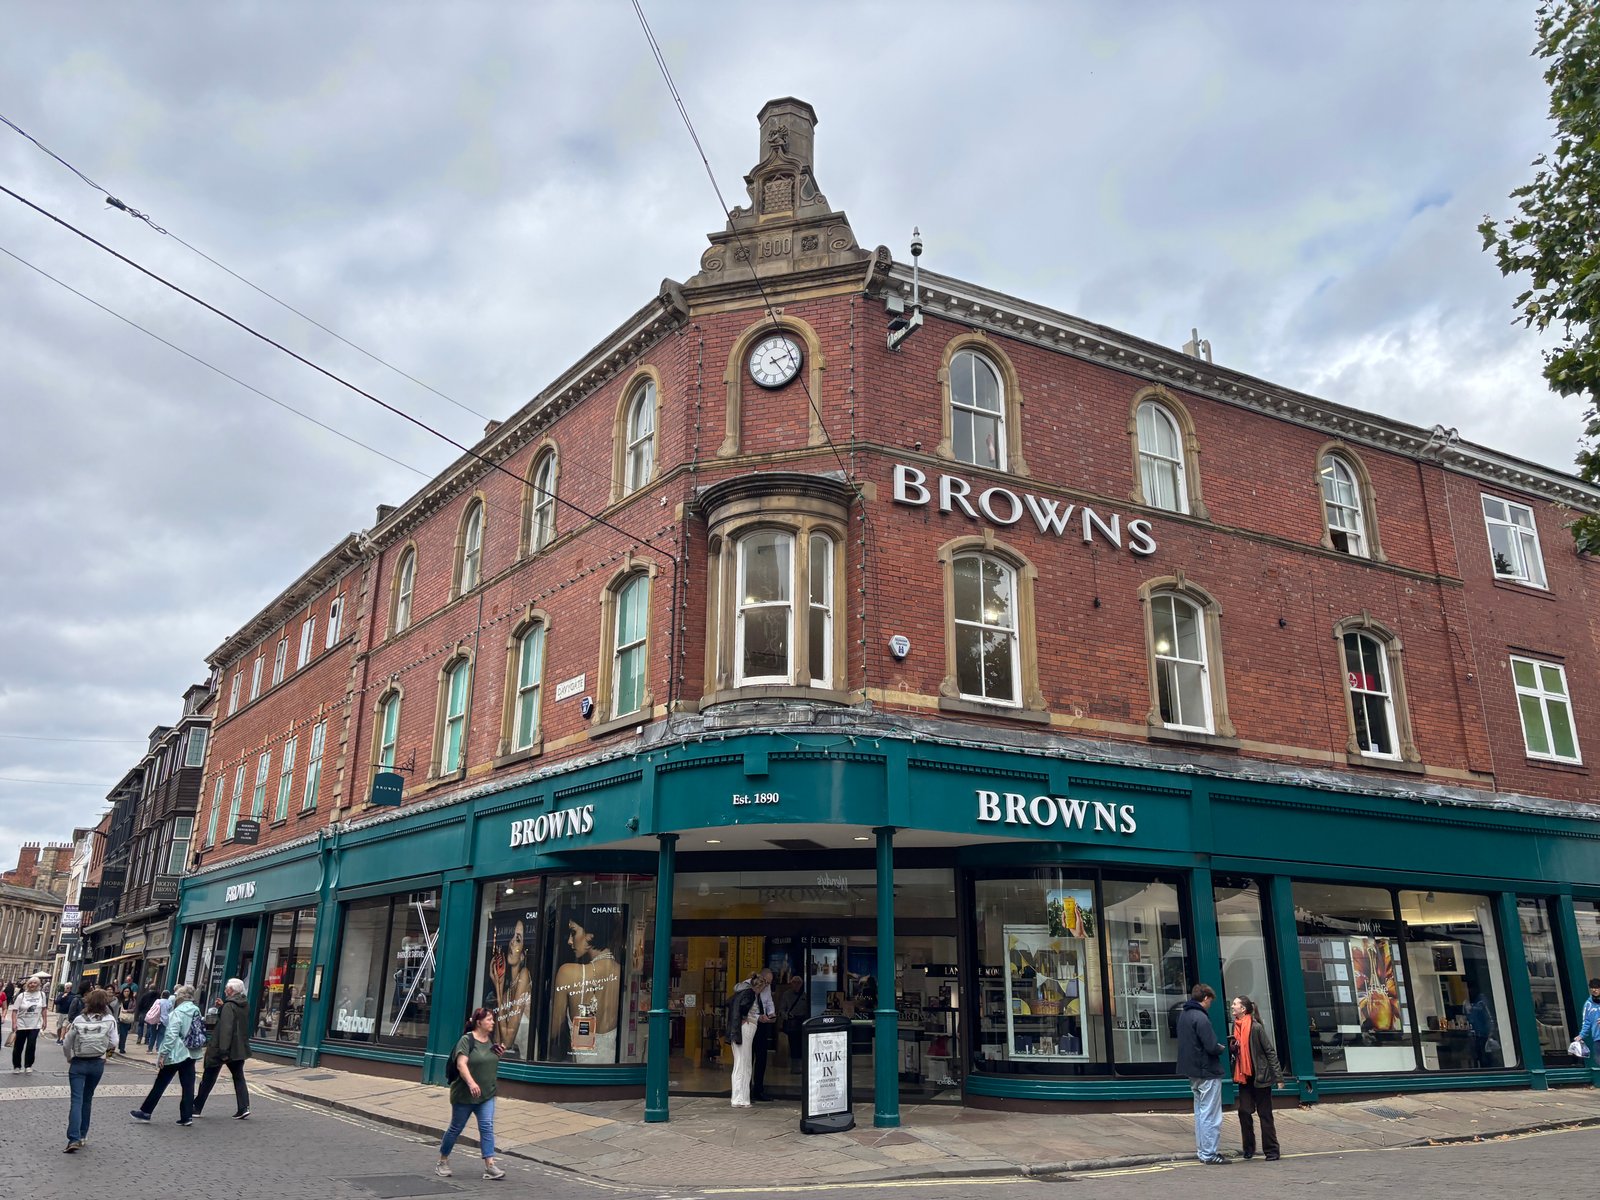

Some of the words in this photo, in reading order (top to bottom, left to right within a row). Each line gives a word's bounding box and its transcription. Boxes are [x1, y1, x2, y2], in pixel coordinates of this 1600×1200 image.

[759, 237, 791, 259] 1900
[893, 463, 1157, 556] BROWNS
[557, 679, 583, 697] DAVYGATE
[732, 794, 751, 805] Est.
[754, 792, 779, 804] 1890
[976, 790, 1137, 834] BROWNS
[509, 804, 594, 848] BROWNS
[225, 880, 257, 902] BROWNS
[337, 1009, 375, 1033] Barbour
[814, 1051, 842, 1063] WALK
[823, 1066, 833, 1077] IN
